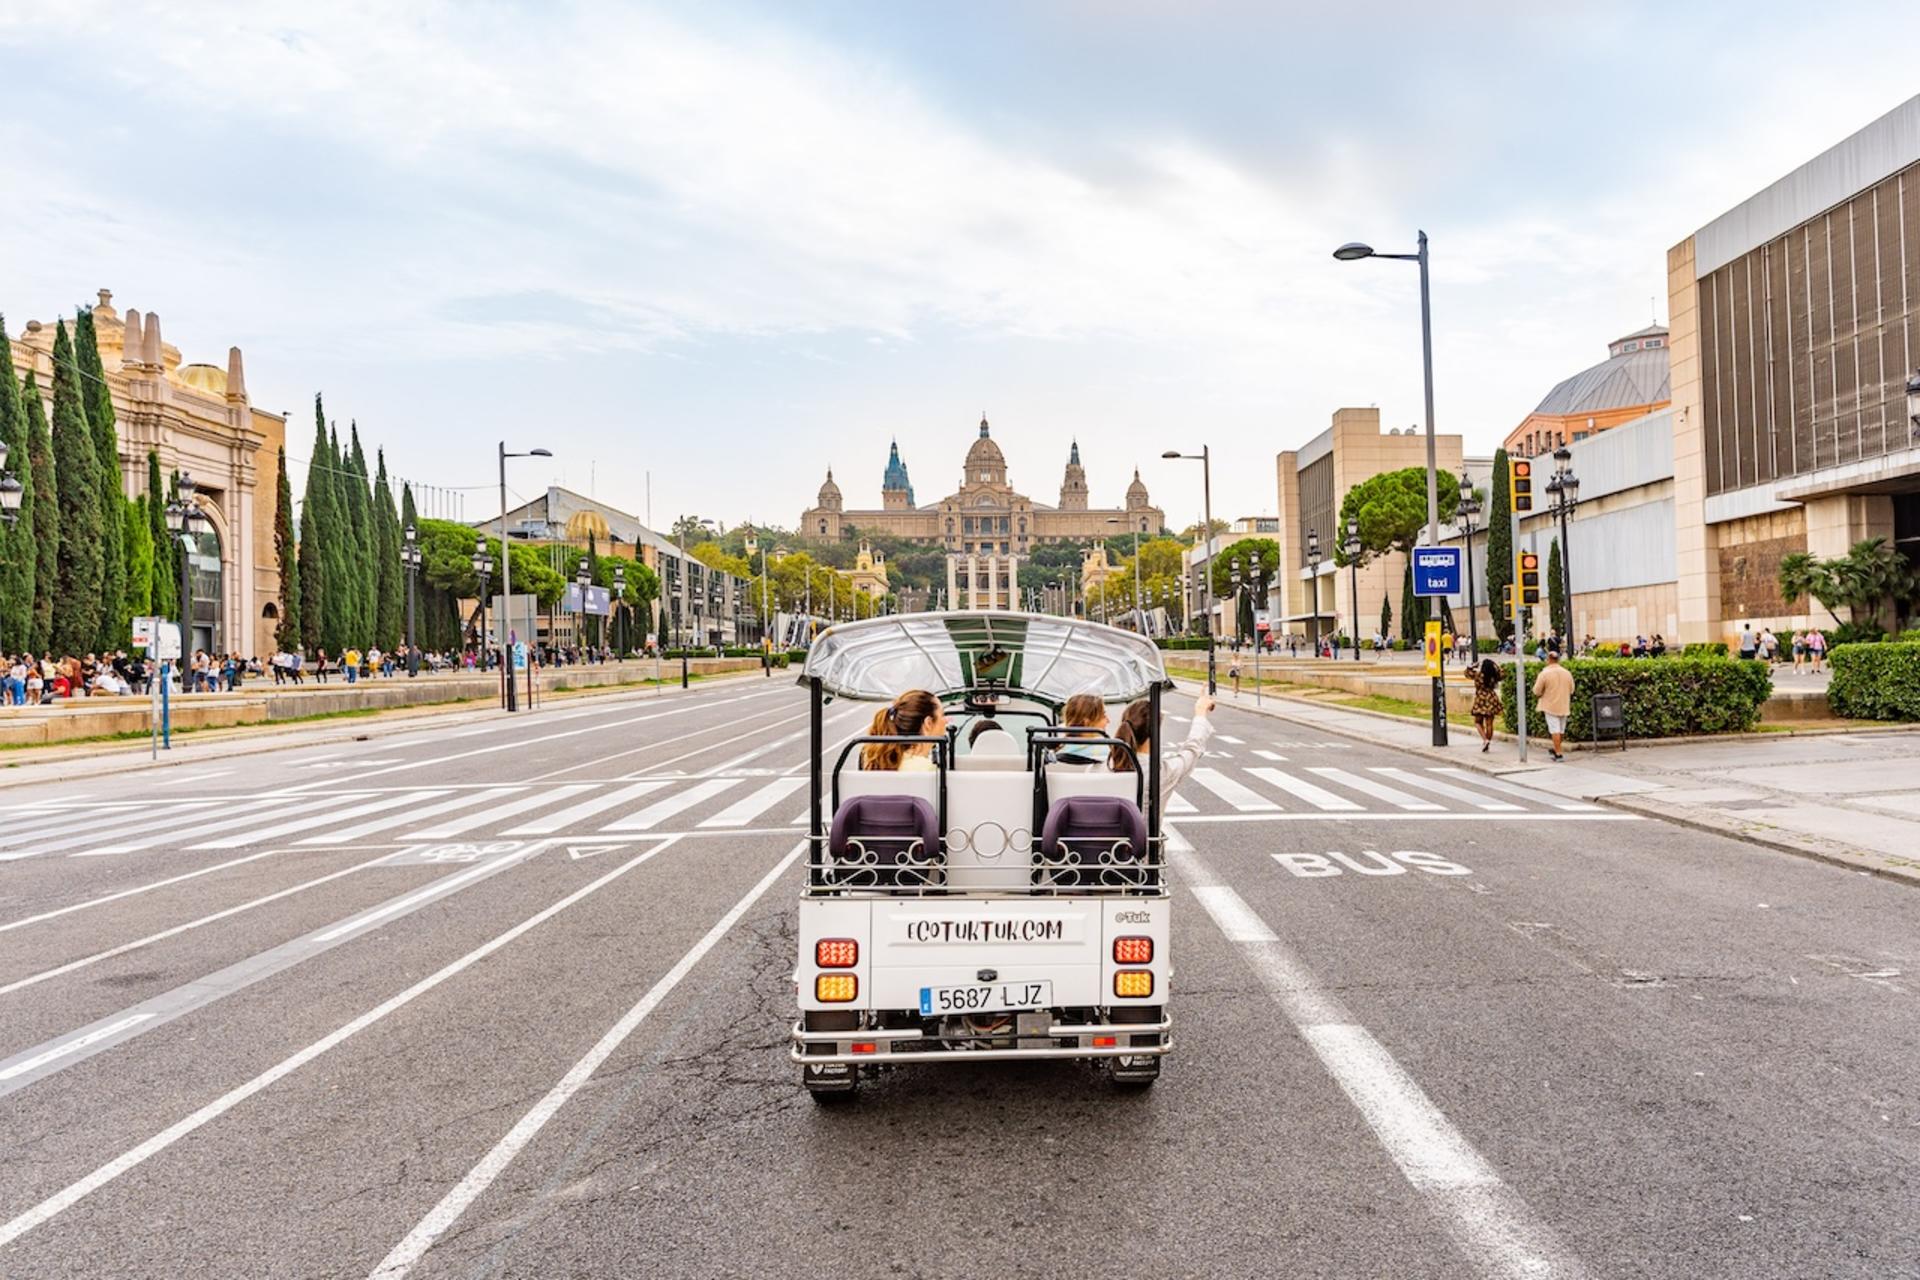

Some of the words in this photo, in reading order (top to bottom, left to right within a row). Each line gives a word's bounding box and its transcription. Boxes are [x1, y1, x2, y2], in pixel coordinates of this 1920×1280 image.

[1427, 577, 1448, 588] taxi
[1270, 850, 1474, 878] BUS
[907, 919, 1063, 942] ECOTUKTUK.COM
[939, 987, 992, 1010] 5687
[1003, 984, 1043, 1007] LJZ
